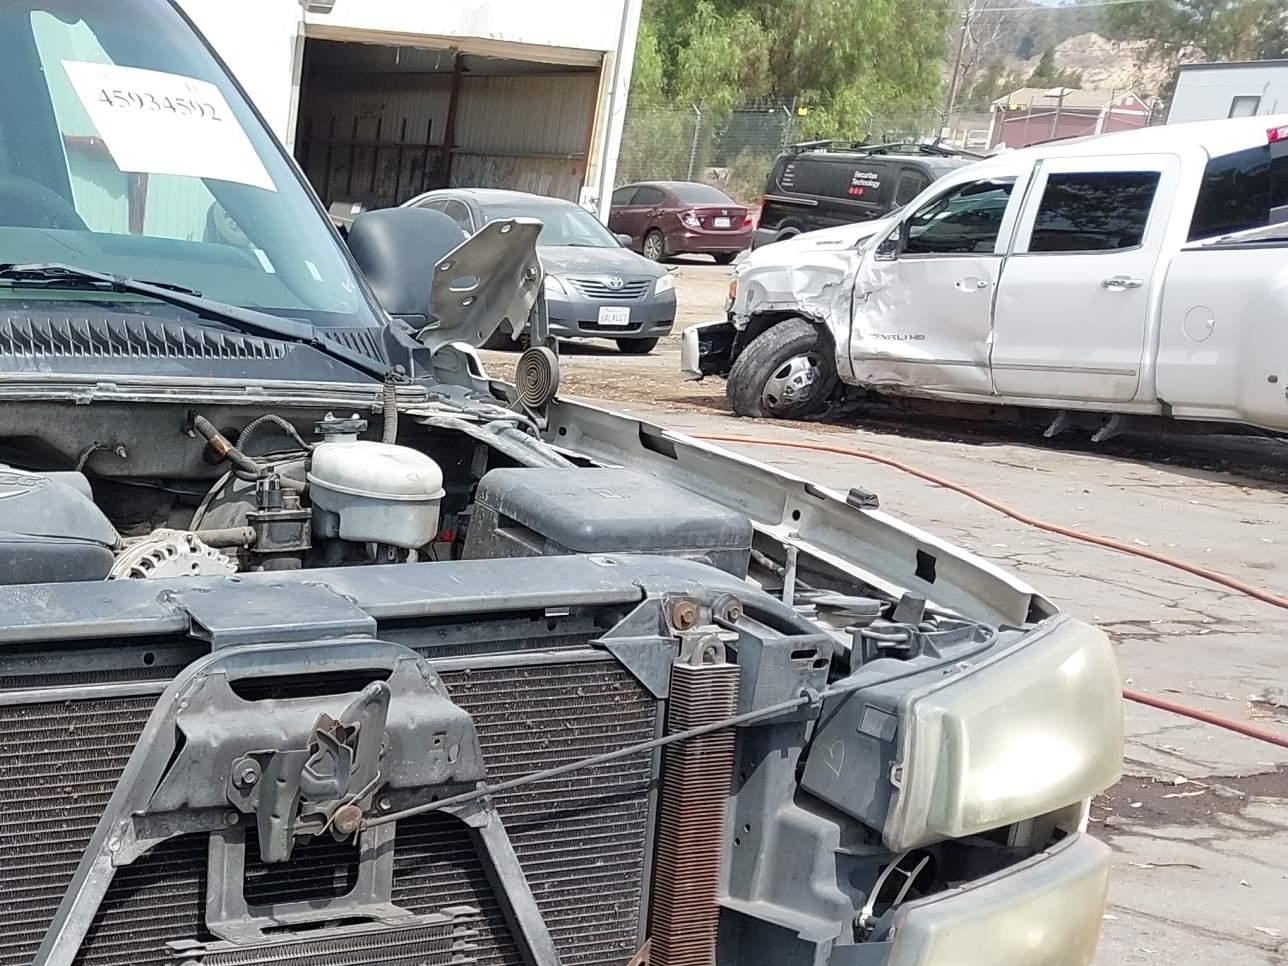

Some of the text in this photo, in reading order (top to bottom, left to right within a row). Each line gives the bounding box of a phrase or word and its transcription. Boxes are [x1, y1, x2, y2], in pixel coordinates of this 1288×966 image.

[98, 88, 222, 122] 45934592
[853, 170, 878, 180] Securitas
[851, 178, 881, 189] Technology
[869, 333, 908, 341] NALI
